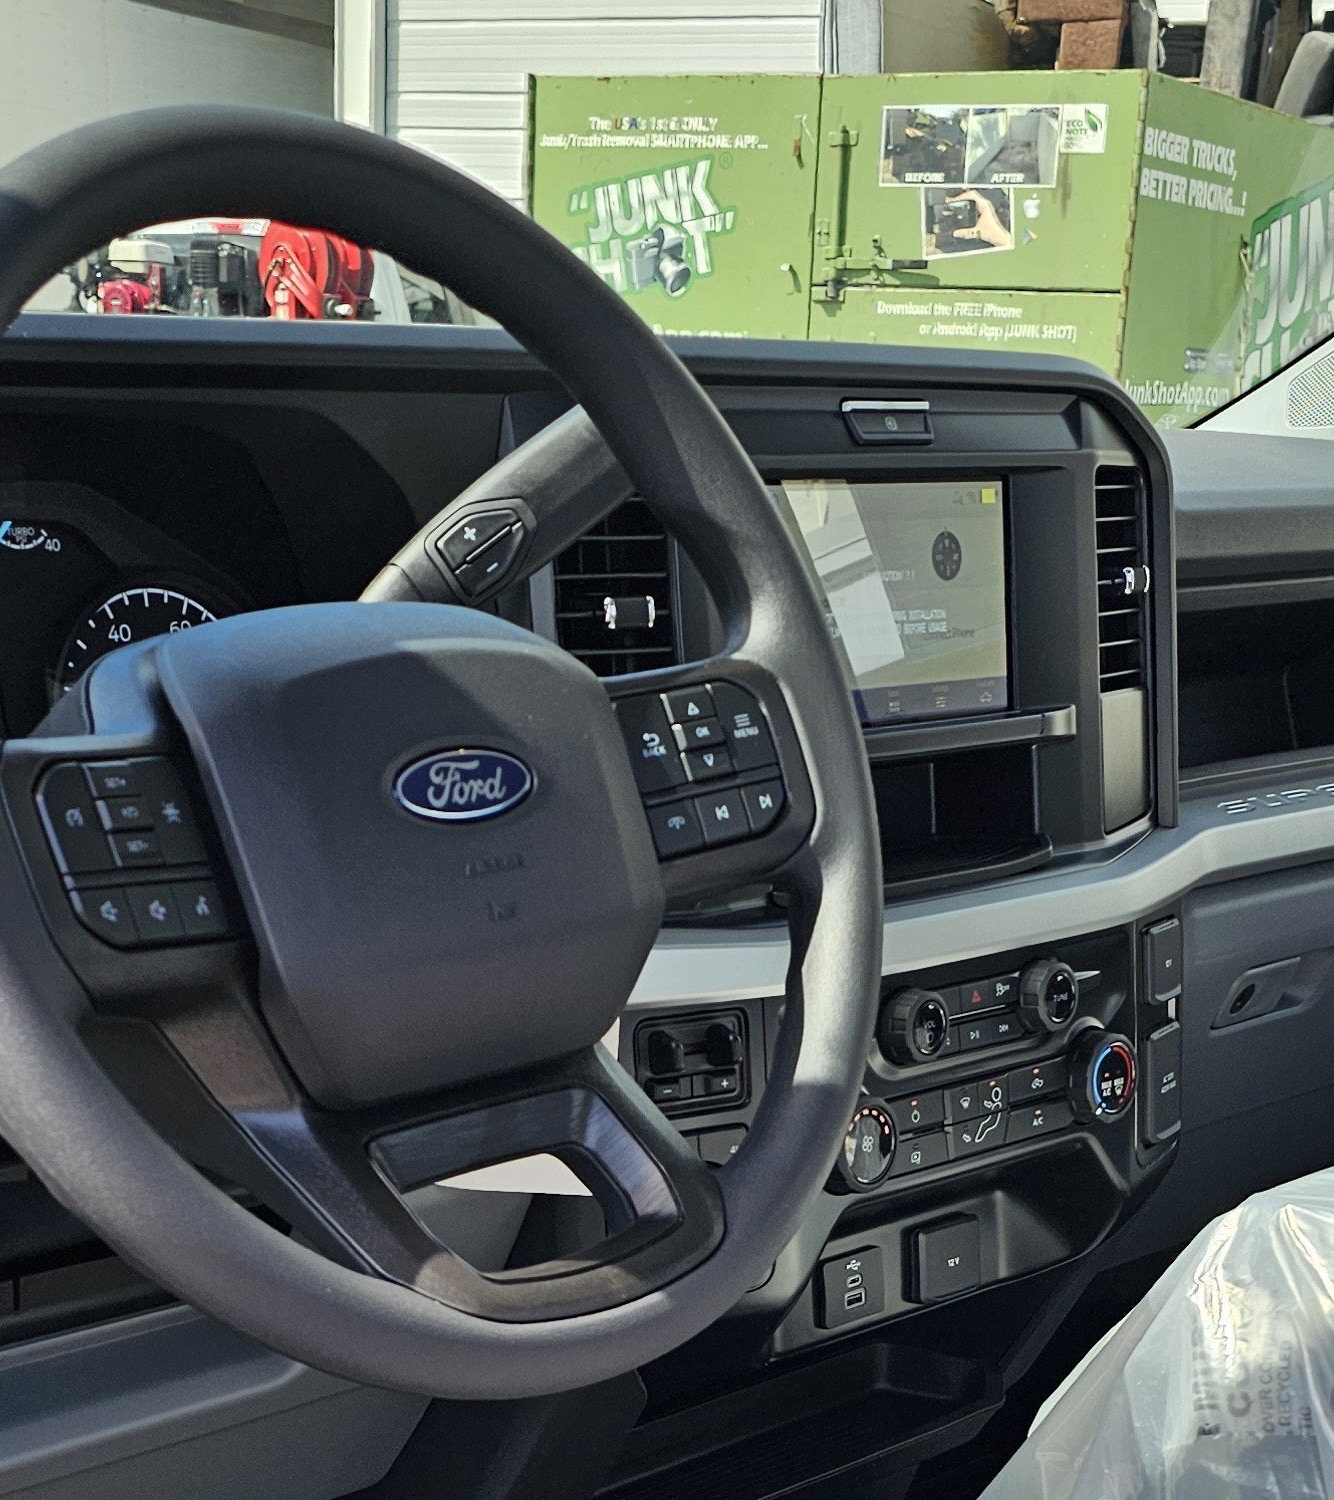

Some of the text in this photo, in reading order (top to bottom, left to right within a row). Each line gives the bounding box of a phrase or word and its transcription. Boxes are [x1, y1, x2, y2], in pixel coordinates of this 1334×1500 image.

[1143, 126, 1237, 182] BIGGER TRUCKS,
[904, 172, 946, 184] BEFORE
[989, 172, 1026, 184] AFTER
[1139, 167, 1188, 204] BETTER
[876, 301, 933, 316] Download
[934, 302, 952, 316] the
[953, 302, 983, 317] FREE
[932, 322, 978, 337] Android
[978, 323, 1004, 341] App
[44, 538, 61, 552] 40
[108, 623, 132, 643] 40
[427, 759, 507, 809] Ford
